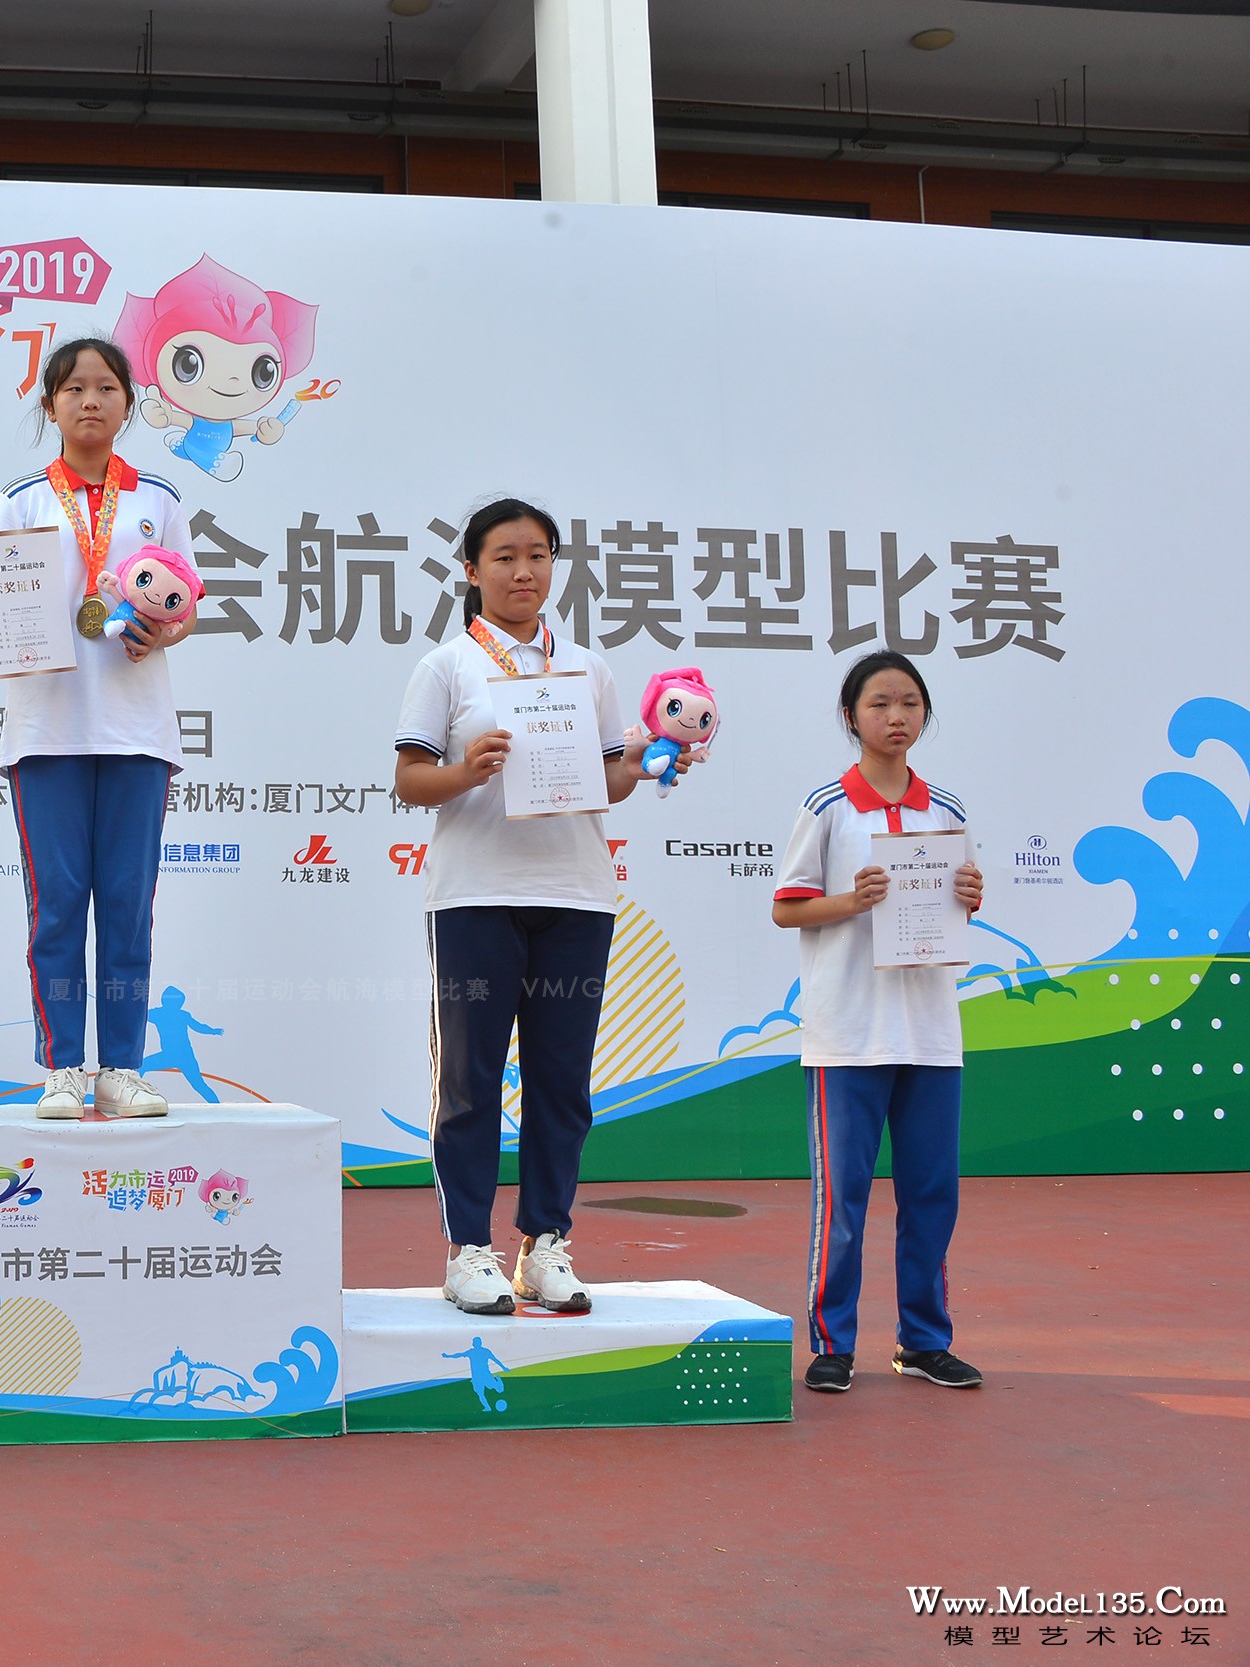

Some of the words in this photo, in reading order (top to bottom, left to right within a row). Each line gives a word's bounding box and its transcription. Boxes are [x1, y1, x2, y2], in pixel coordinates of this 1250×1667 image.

[513, 703, 577, 714] 厦门市第二十届运动会
[527, 720, 573, 733] 获奖证书
[665, 839, 773, 857] Casarte
[890, 862, 949, 871] 厦门市第二十届运动会
[1015, 852, 1061, 867] Hilton
[212, 866, 241, 874] GROUP
[282, 867, 350, 884] 九龙建设
[728, 863, 773, 877] 卡萨帝
[899, 878, 943, 891] 获奖证书
[82, 1169, 165, 1198] 活力市运
[170, 1169, 196, 1183] 2019
[107, 1187, 185, 1211] 追梦厦门
